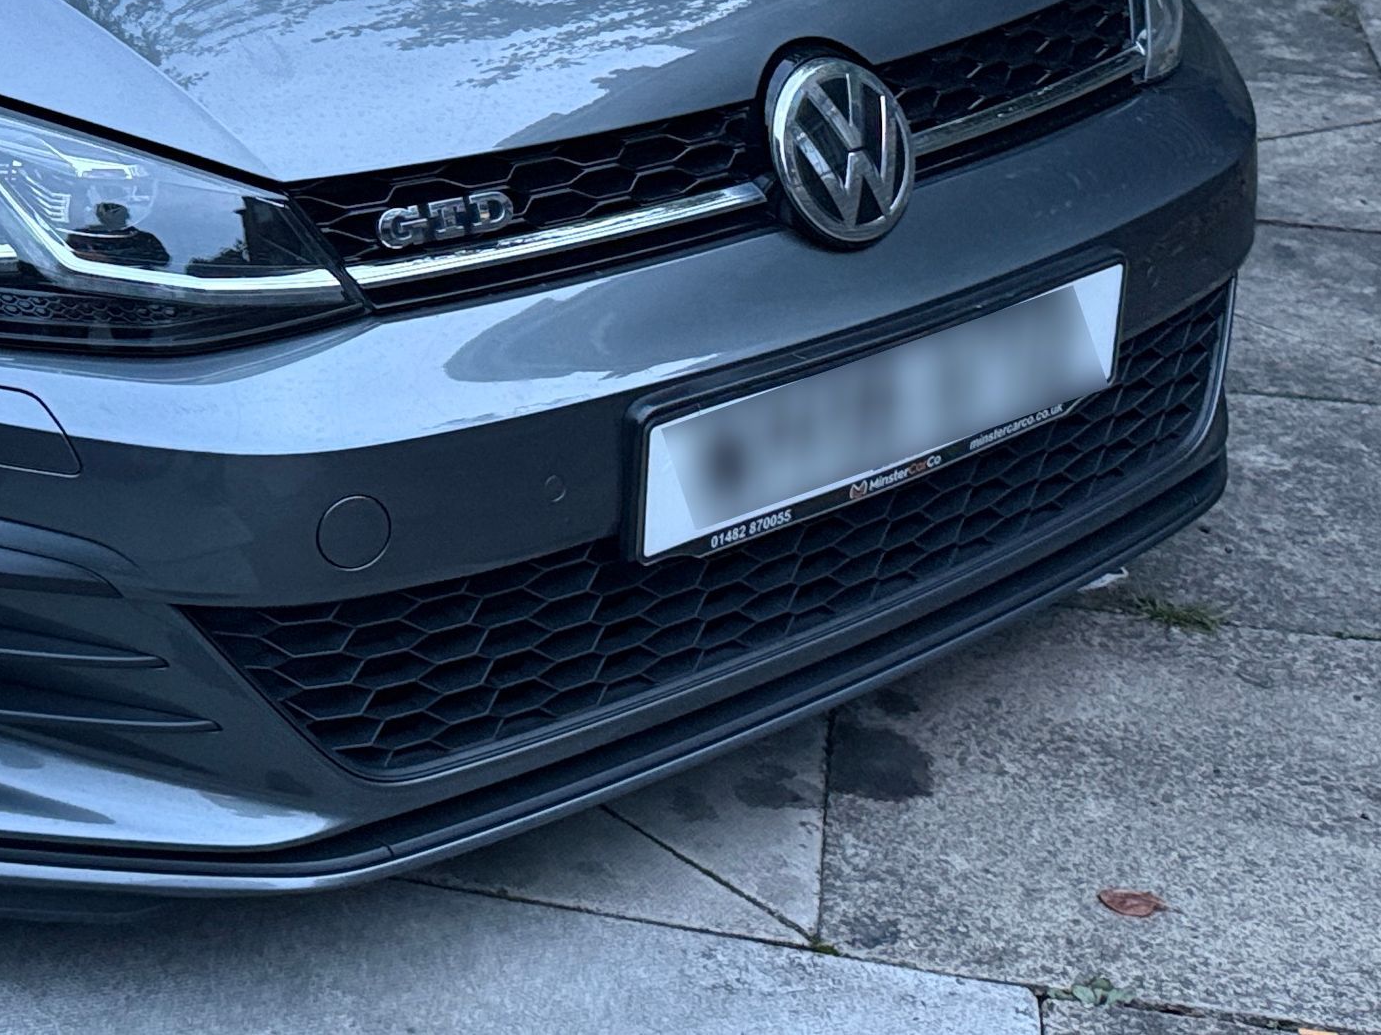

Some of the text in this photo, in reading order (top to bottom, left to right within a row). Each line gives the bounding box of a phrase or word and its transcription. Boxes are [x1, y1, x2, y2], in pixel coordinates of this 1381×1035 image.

[378, 191, 514, 249] GTD
[969, 403, 1063, 450] minstercarco.co.uk
[710, 508, 793, 548] 01482 870055
